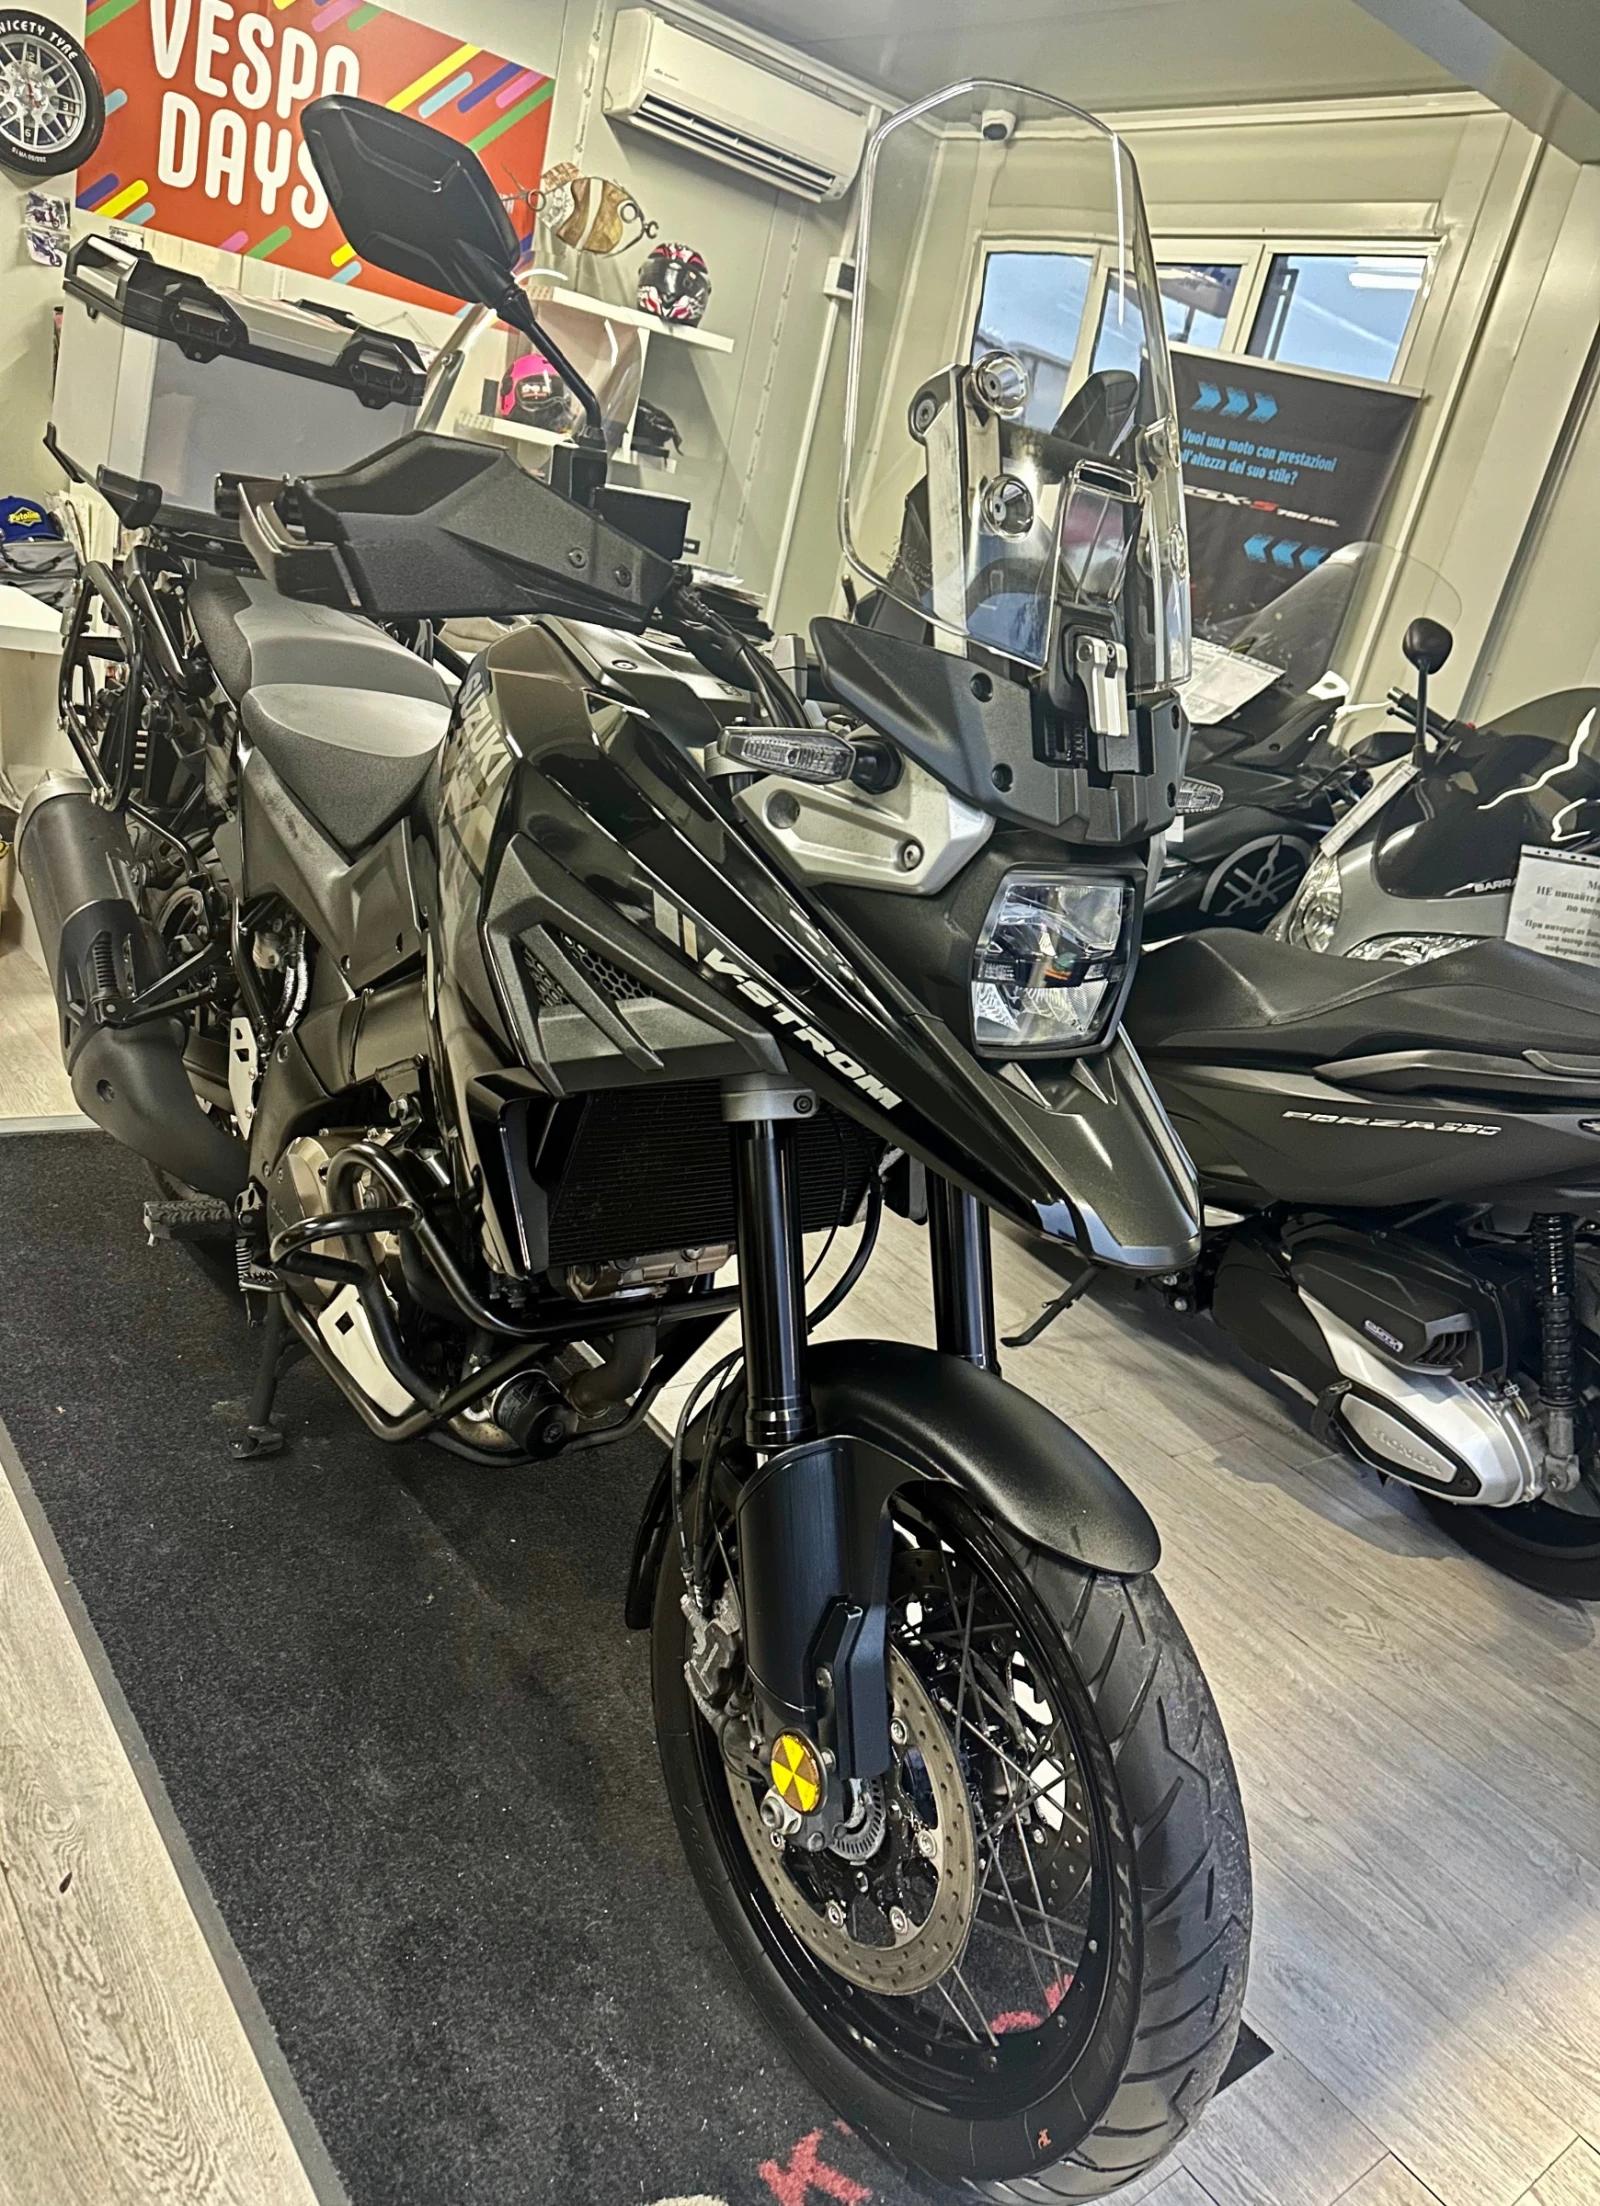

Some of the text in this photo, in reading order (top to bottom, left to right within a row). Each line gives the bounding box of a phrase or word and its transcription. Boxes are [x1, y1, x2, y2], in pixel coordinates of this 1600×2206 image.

[0, 20, 78, 60] NICETY TYRE
[157, 91, 329, 229] DAYS
[1182, 428, 1338, 472] Vuoi una moto con prestazioni
[1228, 459, 1245, 475] del
[1246, 466, 1266, 480] suo
[1267, 467, 1299, 486] stile?
[458, 671, 512, 787] SUZUKI
[1536, 885, 1553, 896] НЕ
[703, 947, 903, 1110] V-STROM
